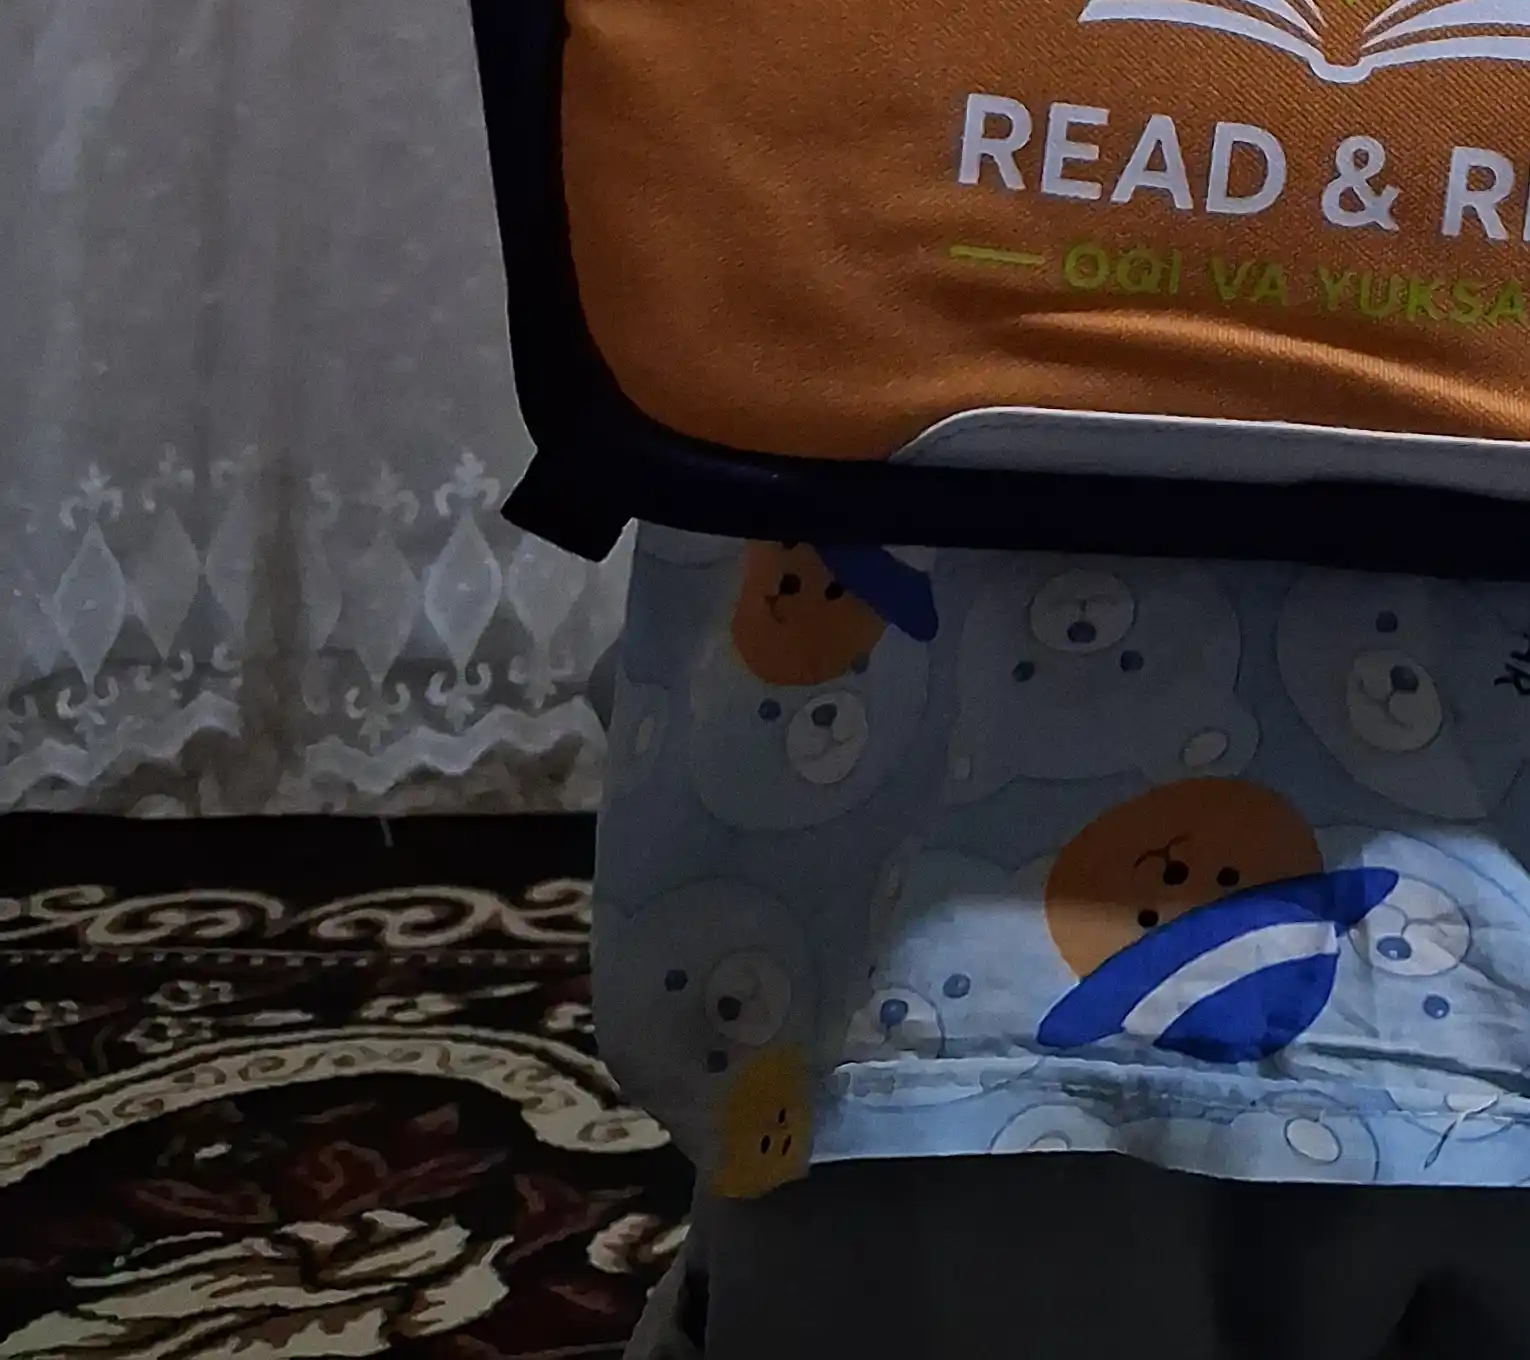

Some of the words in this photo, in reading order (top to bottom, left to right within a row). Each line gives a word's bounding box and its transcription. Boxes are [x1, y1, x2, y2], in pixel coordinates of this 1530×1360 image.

[958, 92, 1288, 214] READ
[1321, 135, 1399, 232] &
[1211, 257, 1288, 306] VA
